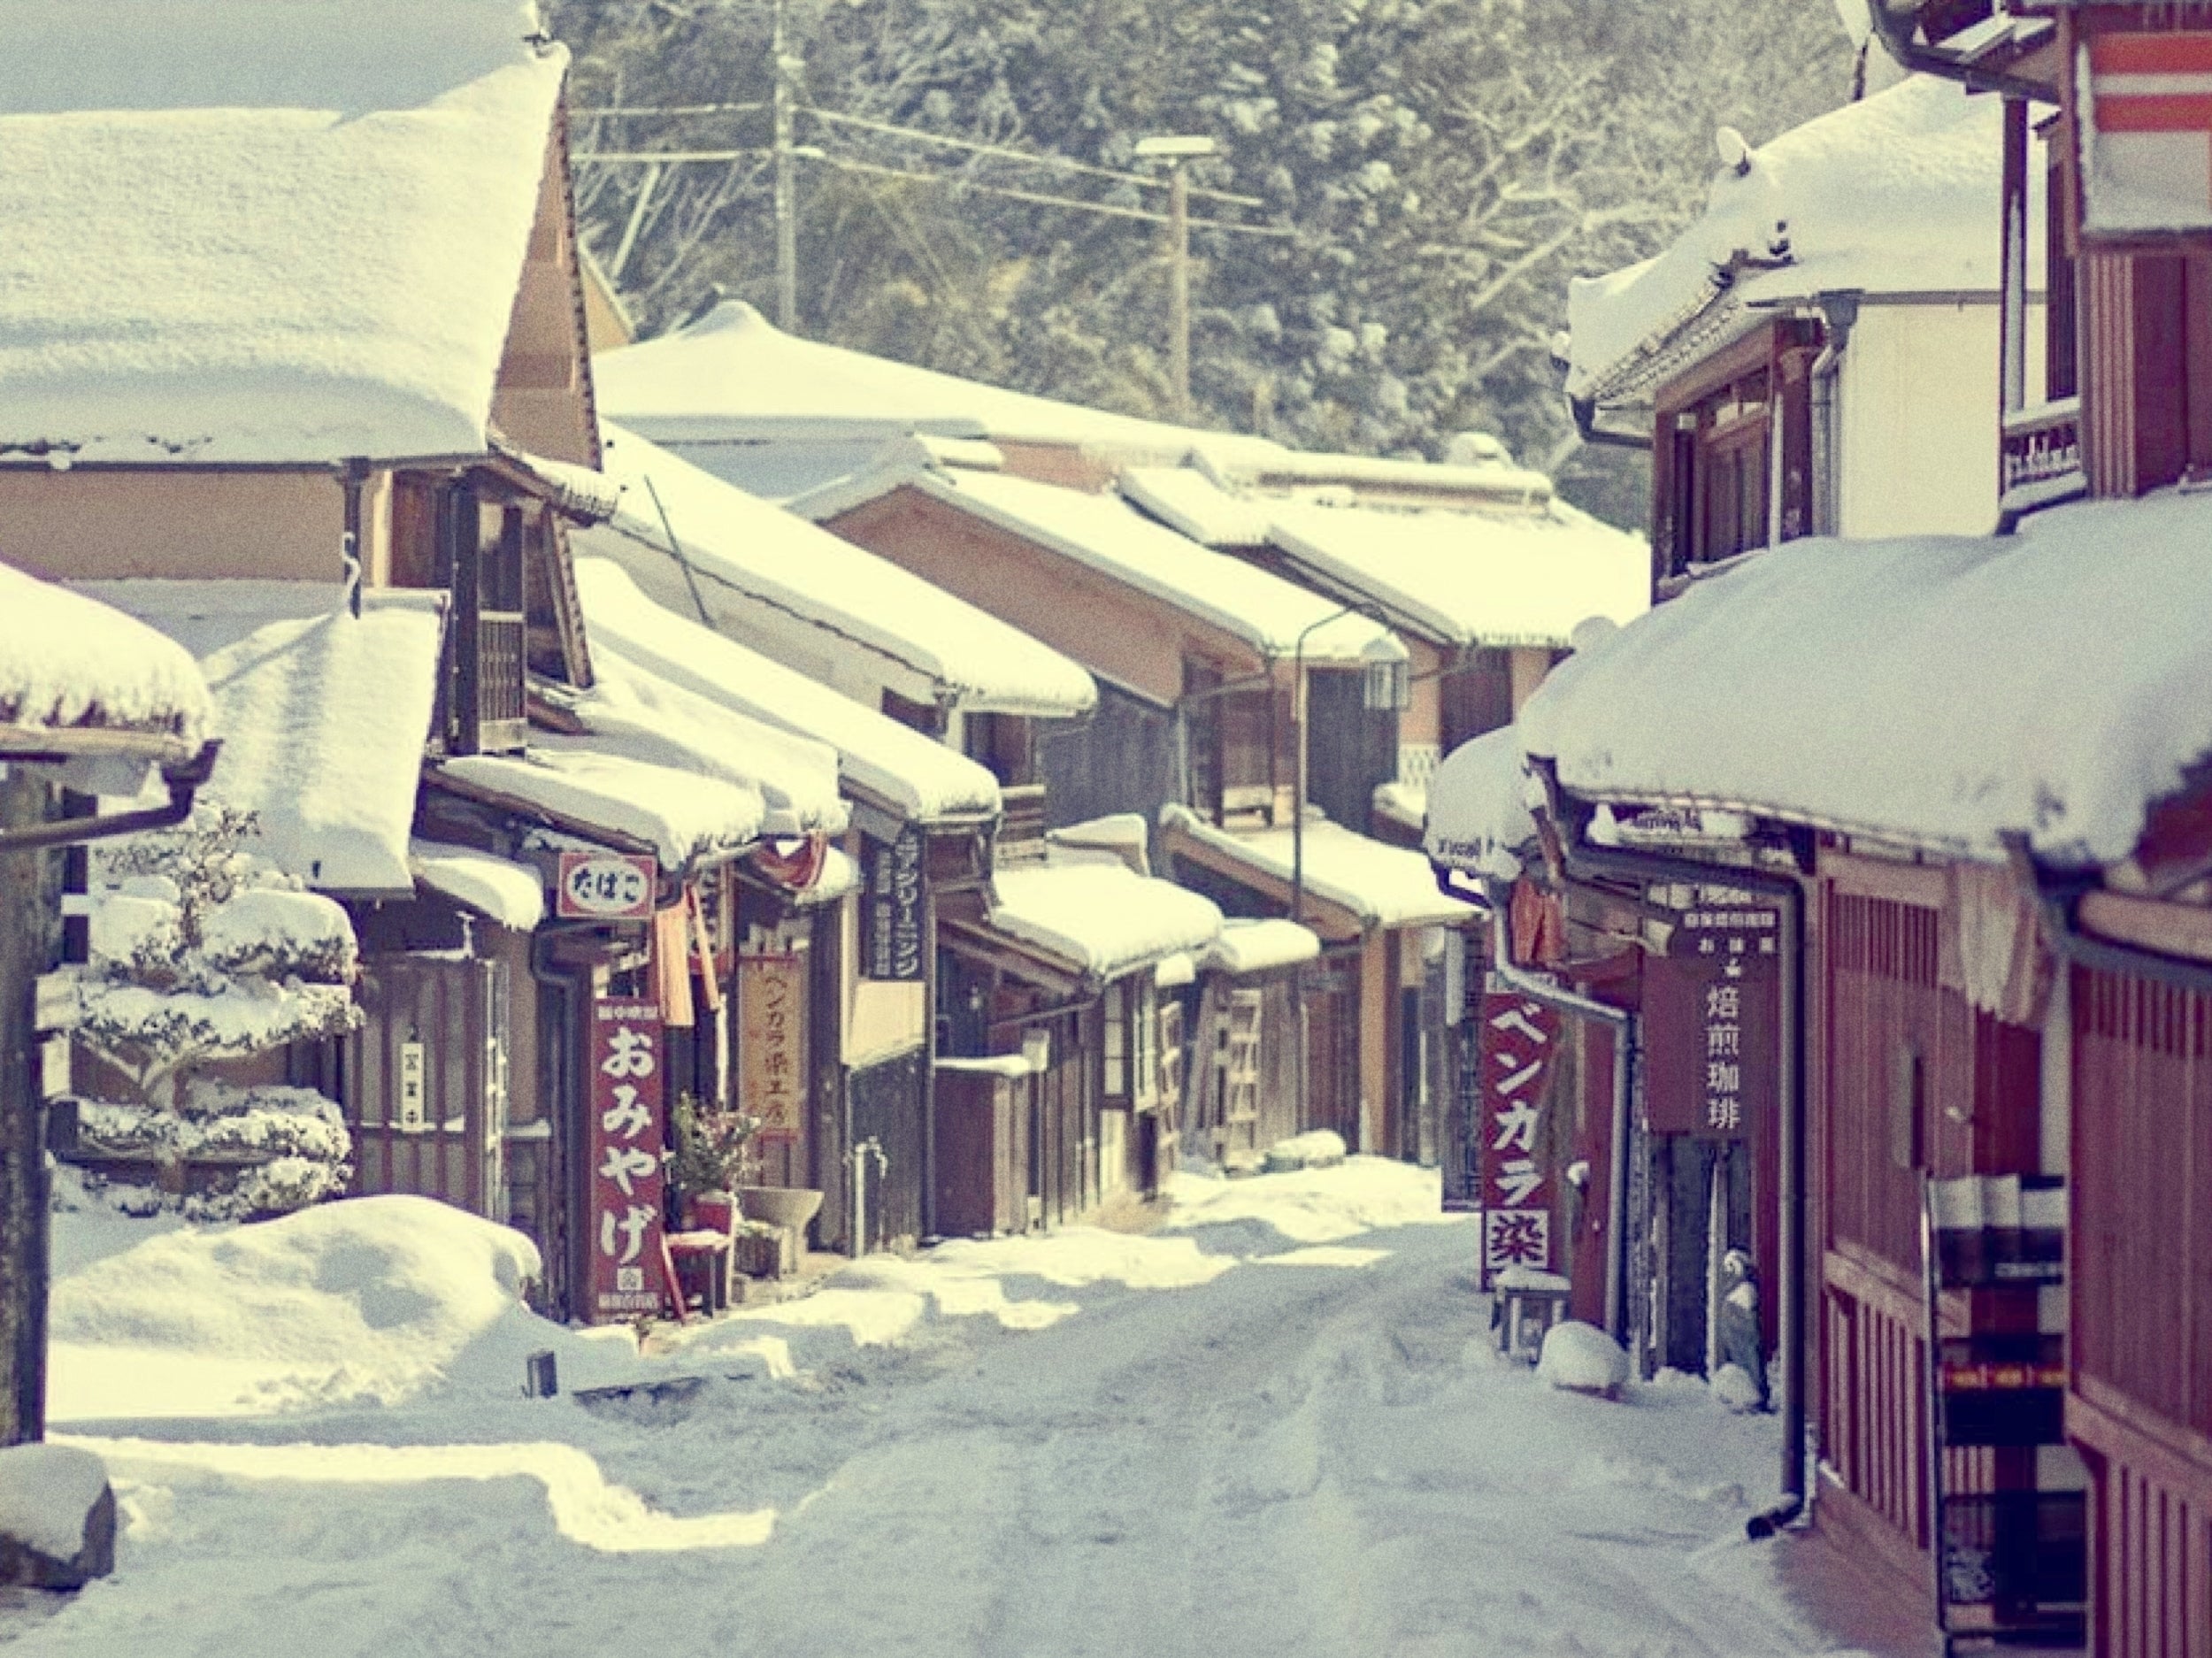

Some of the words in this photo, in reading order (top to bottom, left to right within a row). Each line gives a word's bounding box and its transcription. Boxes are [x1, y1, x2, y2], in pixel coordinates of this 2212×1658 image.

[599, 1025, 658, 1264] おみやげ
[1705, 985, 1741, 1129] 焙煎珈琲
